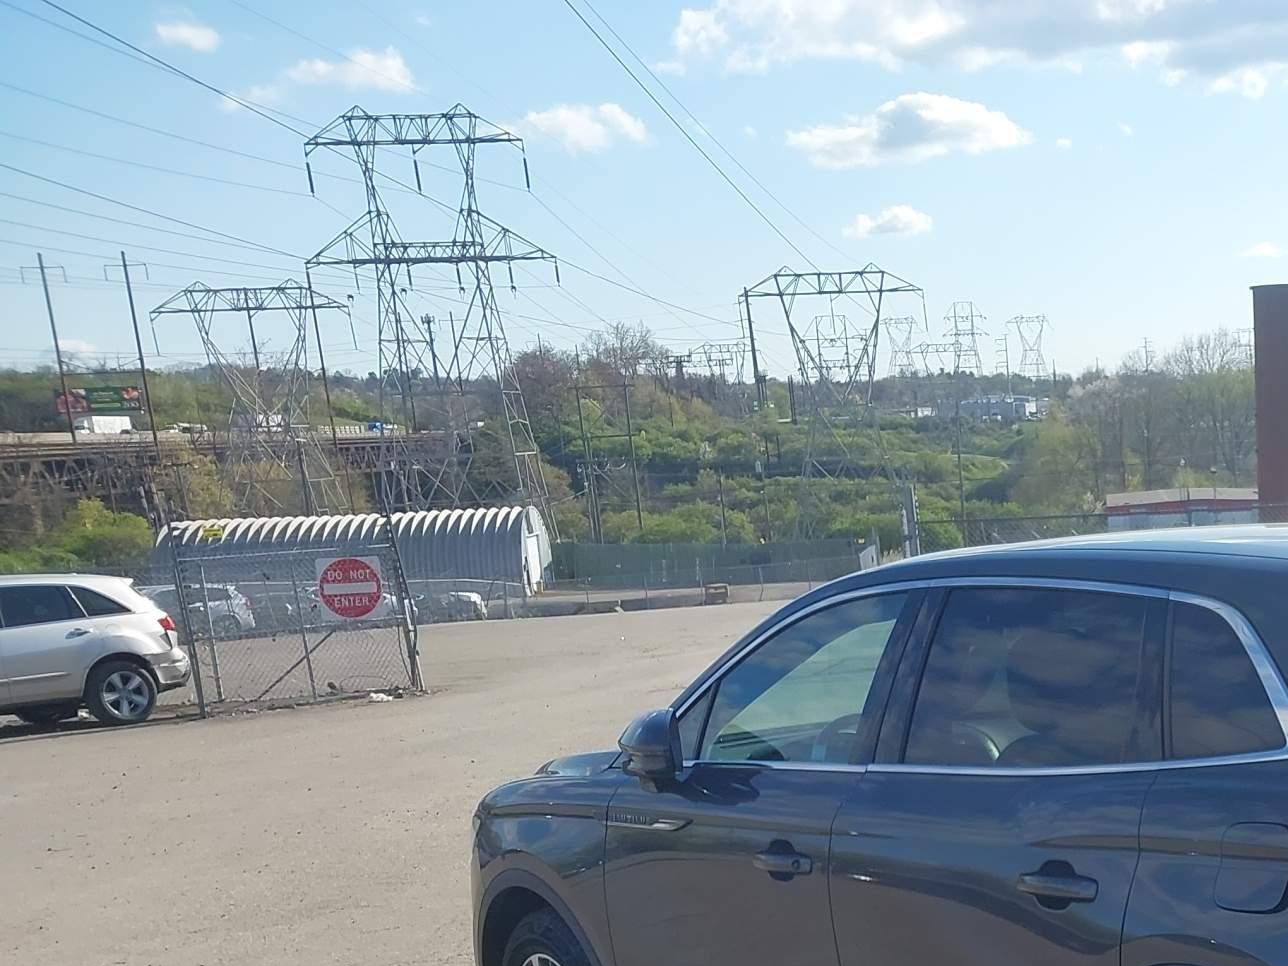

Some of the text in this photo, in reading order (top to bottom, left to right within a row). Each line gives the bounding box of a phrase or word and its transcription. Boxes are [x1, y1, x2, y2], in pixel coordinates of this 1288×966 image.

[327, 569, 370, 581] DO NOT
[334, 596, 369, 607] ENTER
